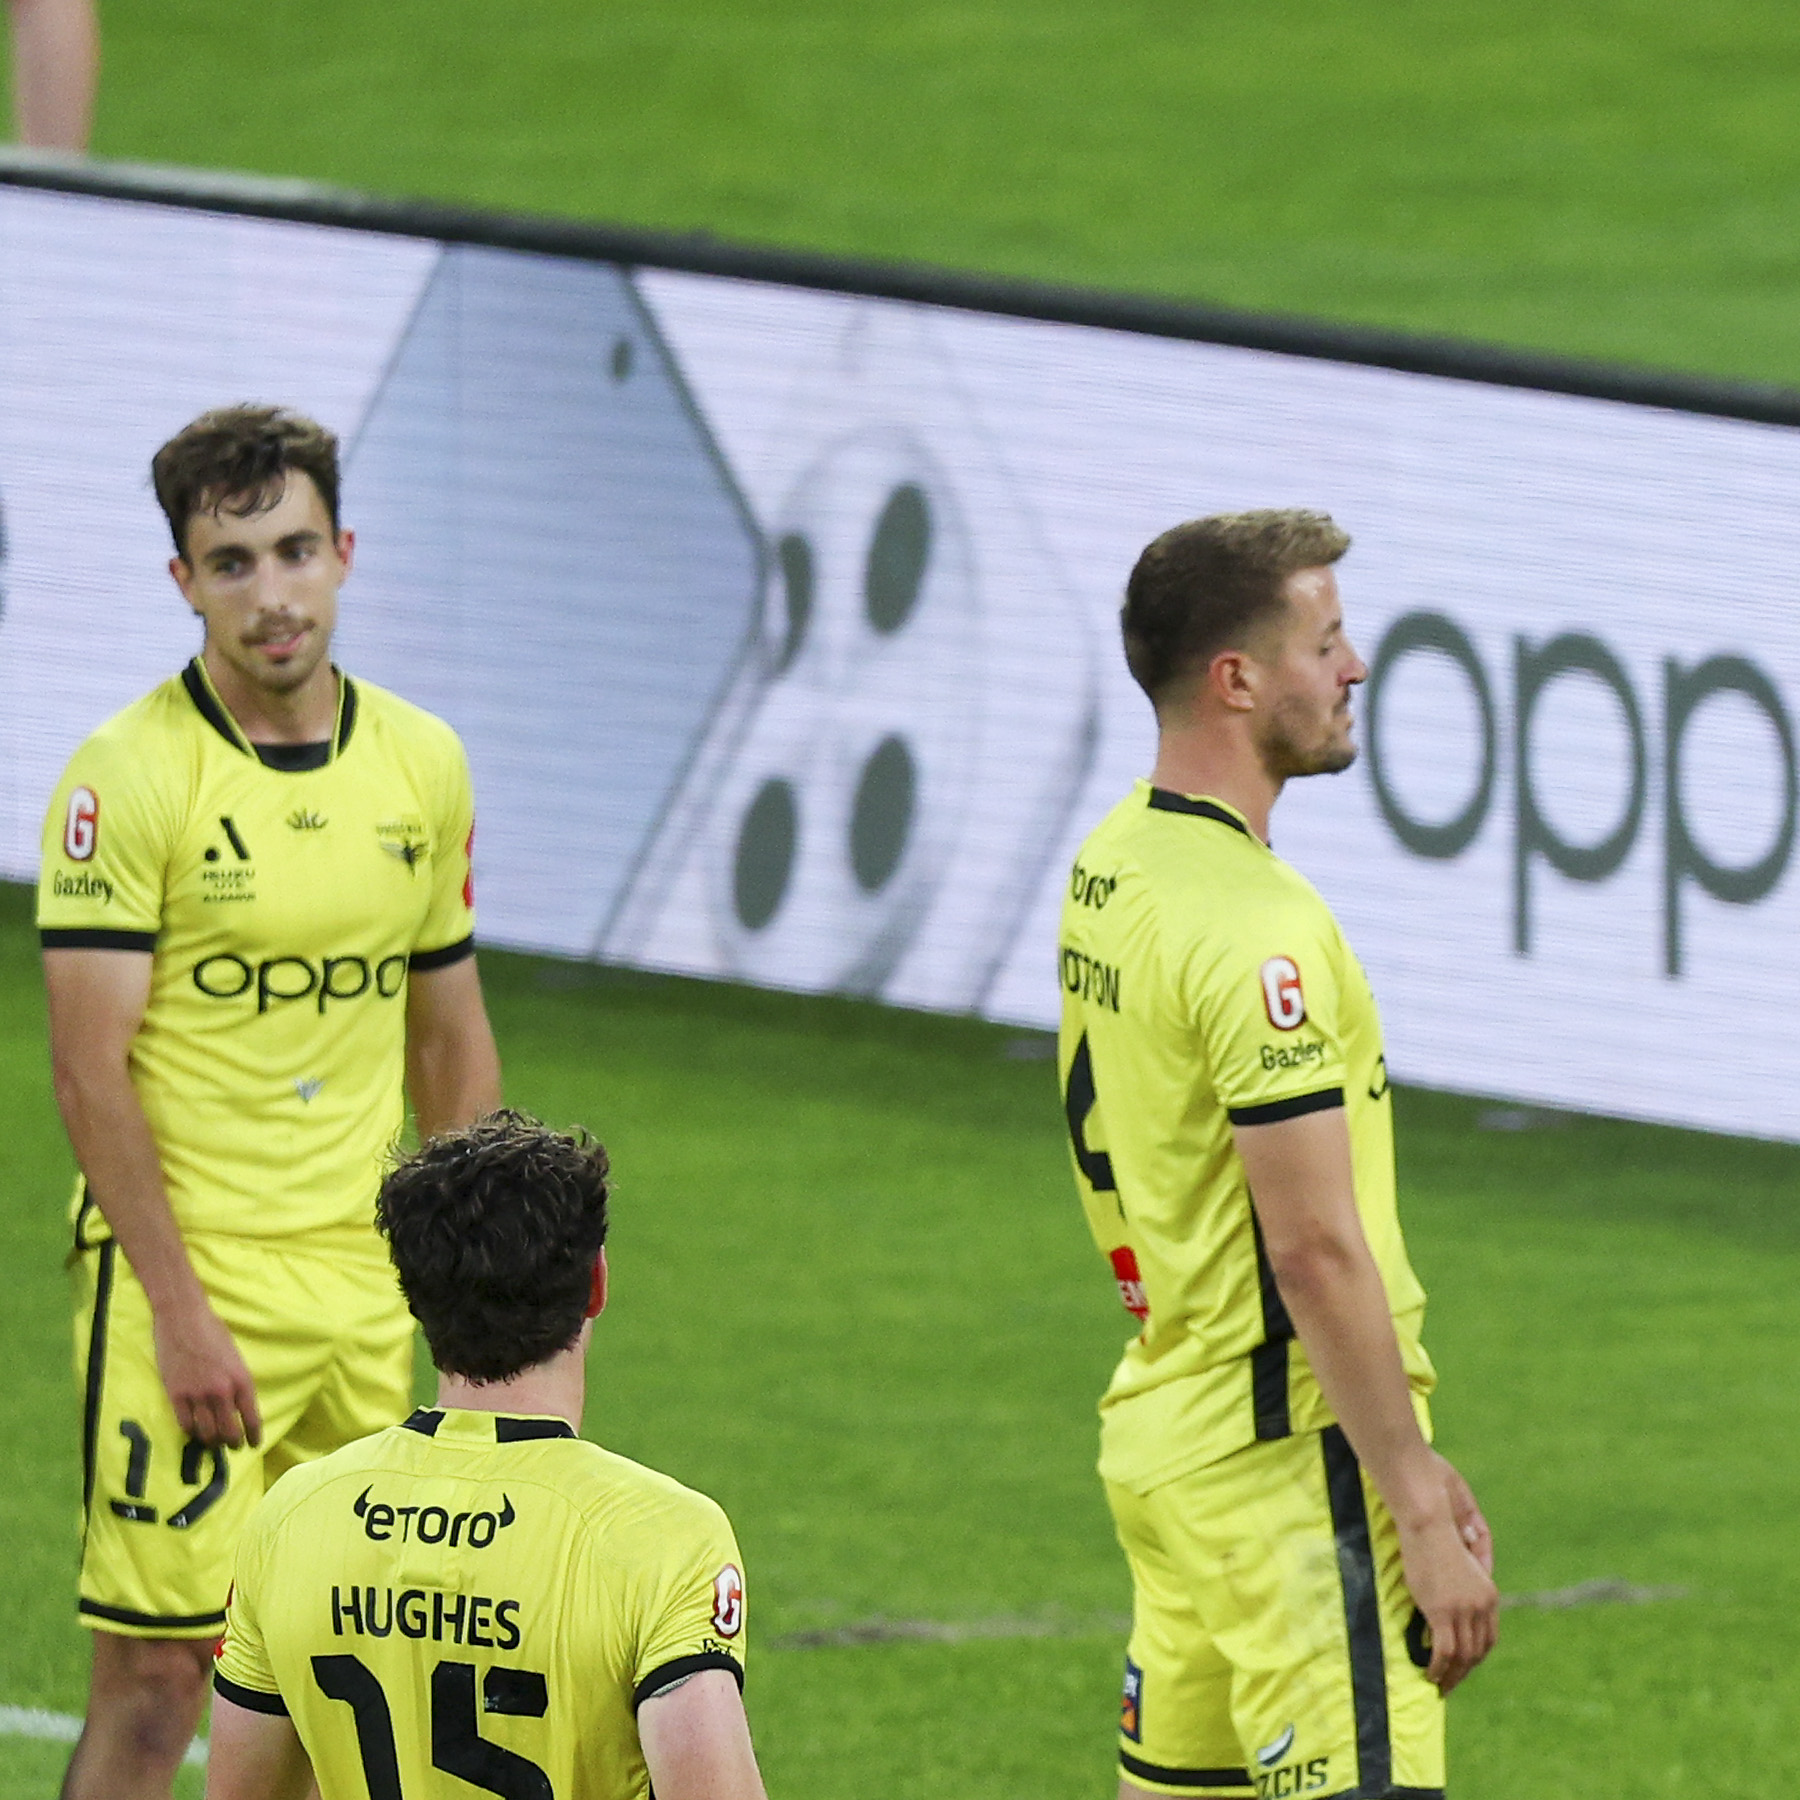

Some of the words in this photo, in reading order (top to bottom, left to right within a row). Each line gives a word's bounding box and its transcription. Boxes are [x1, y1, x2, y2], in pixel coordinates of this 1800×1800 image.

[53, 870, 113, 904] Gazley
[193, 953, 405, 1014] oppo
[1260, 1038, 1325, 1072] Gazley
[331, 1585, 521, 1650] HUGHES
